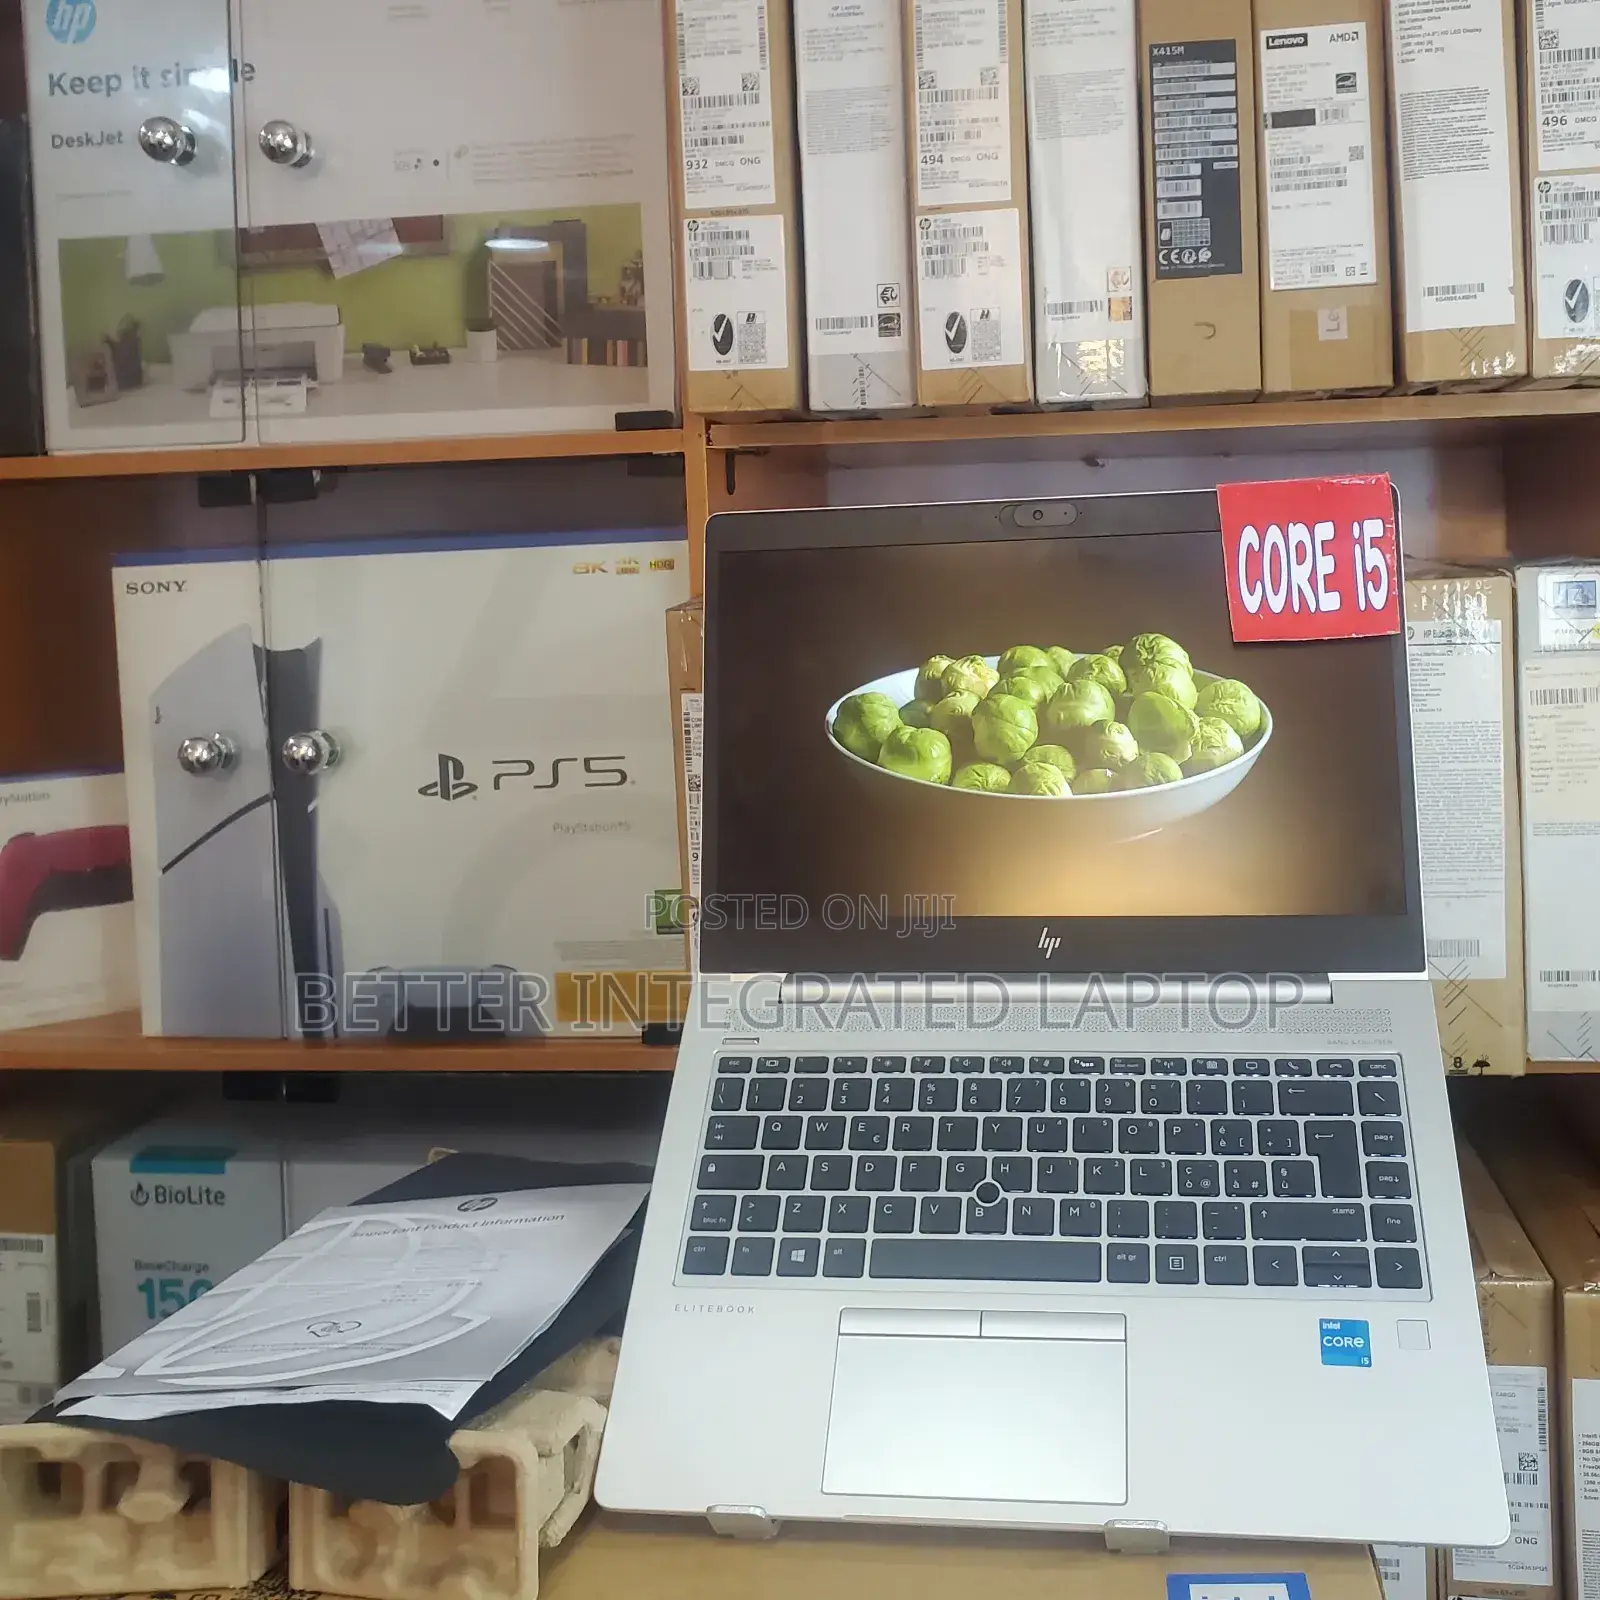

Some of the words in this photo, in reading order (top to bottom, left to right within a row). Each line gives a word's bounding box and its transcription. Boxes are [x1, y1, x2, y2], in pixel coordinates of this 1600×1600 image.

[1268, 35, 1306, 47] Lenovo
[1329, 33, 1351, 43] AMD
[1152, 46, 1185, 56] X415M
[49, 72, 122, 98] Keep
[132, 64, 151, 90] it
[160, 58, 256, 88] sile
[1542, 116, 1568, 127] 496
[51, 130, 124, 150] DeskJet
[686, 159, 708, 170] 932
[740, 157, 761, 167] ONG
[920, 154, 944, 165] 494
[1237, 520, 1341, 614] CORE
[1352, 518, 1390, 612] i5
[126, 580, 188, 595] SONY
[492, 756, 628, 790] PS5
[1453, 1056, 1462, 1069] 8
[927, 1083, 936, 1092] %
[797, 1096, 803, 1104] 2
[840, 1096, 846, 1104] 3
[883, 1096, 890, 1104] 4
[926, 1096, 933, 1105] 5
[970, 1096, 977, 1105] 6
[1014, 1096, 1021, 1105] 7
[1060, 1097, 1067, 1106] 8
[1104, 1097, 1112, 1106] 9
[772, 1122, 782, 1132] Q
[816, 1122, 829, 1131] W
[858, 1122, 866, 1131] E
[902, 1123, 910, 1132] R
[946, 1123, 954, 1132] T
[991, 1124, 1000, 1133] Y
[1036, 1124, 1045, 1134] U
[1127, 1125, 1138, 1135] O
[1173, 1126, 1182, 1135] P
[776, 1162, 786, 1171] A
[821, 1162, 829, 1171] S
[865, 1162, 874, 1172] D
[909, 1163, 917, 1172] F
[956, 1163, 965, 1172] G
[1001, 1163, 1009, 1173] H
[1046, 1164, 1053, 1174] J
[1093, 1166, 1101, 1175] K
[1139, 1167, 1147, 1176] L
[1200, 1178, 1211, 1188] @
[155, 1186, 226, 1206] BioLite
[792, 1203, 801, 1213] Z
[837, 1204, 847, 1213] X
[883, 1204, 893, 1214] C
[930, 1204, 939, 1214] V
[975, 1207, 984, 1217] B
[1022, 1206, 1031, 1215] N
[1070, 1207, 1080, 1217] M
[1332, 1207, 1355, 1215] stamp
[1386, 1217, 1401, 1225] fine
[352, 1225, 420, 1239] Important
[423, 1220, 479, 1234] Product
[480, 1213, 565, 1228] Information
[674, 1303, 756, 1314] ELITEBOOK
[1322, 1322, 1340, 1330] intel
[1515, 1536, 1538, 1545] ONG
